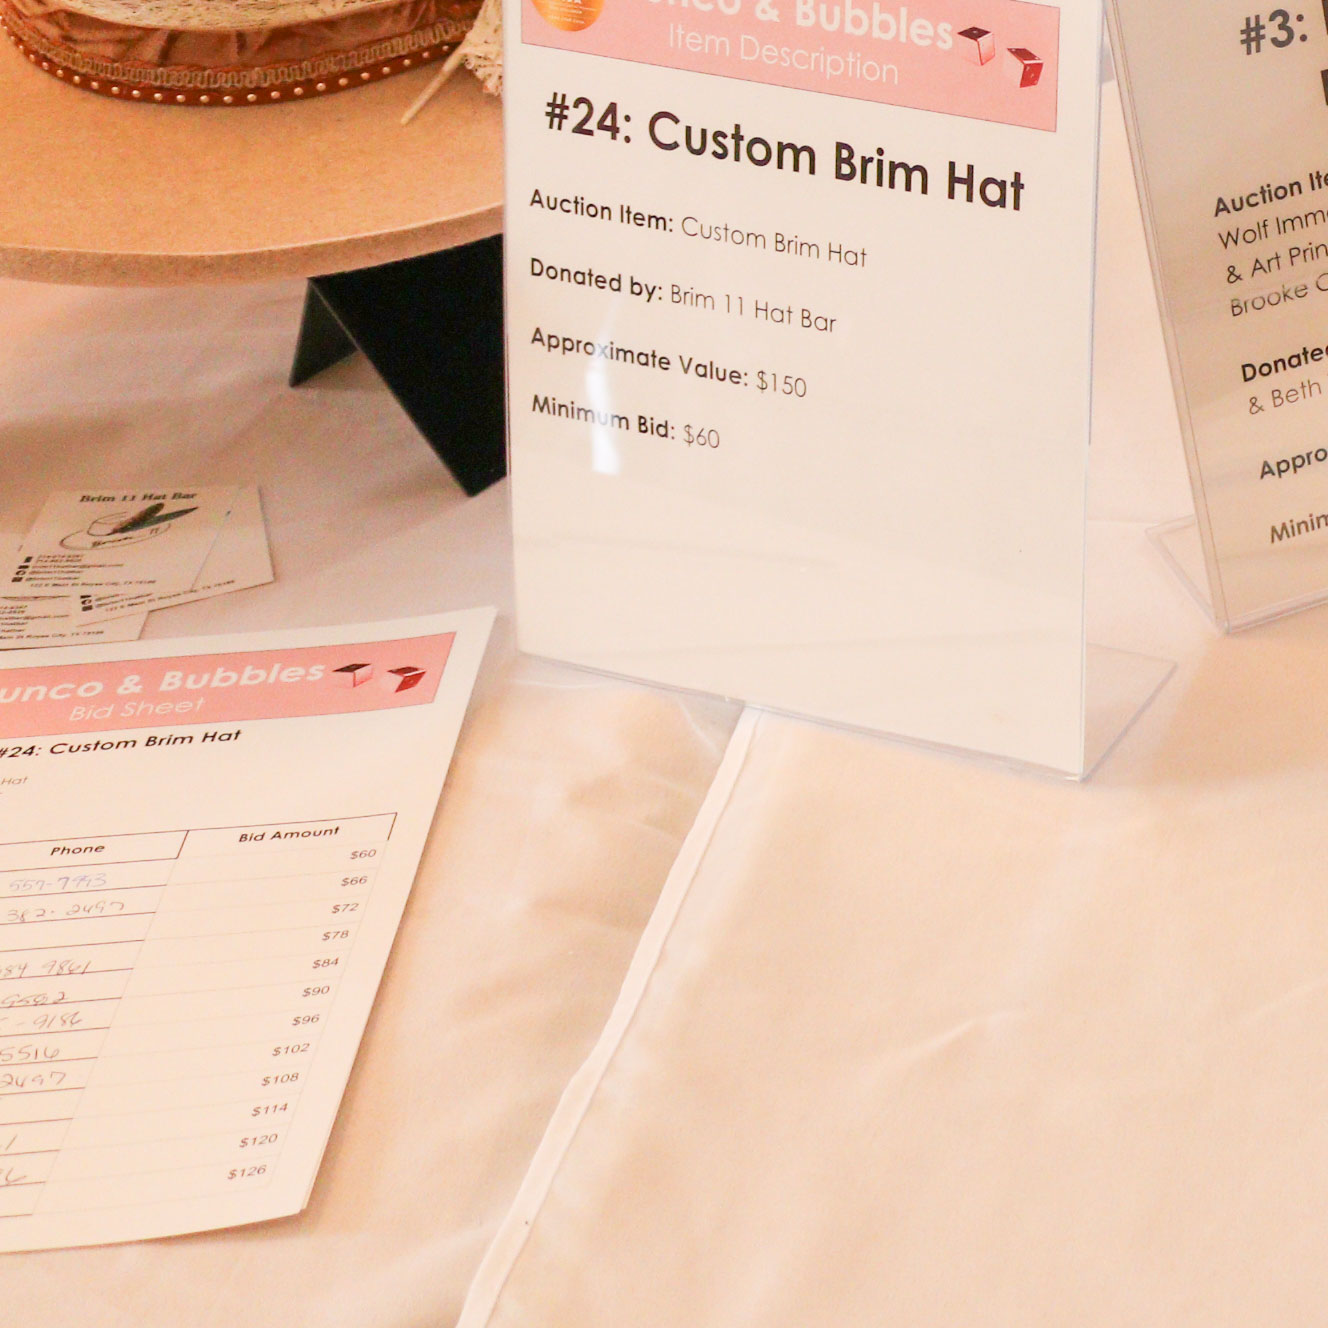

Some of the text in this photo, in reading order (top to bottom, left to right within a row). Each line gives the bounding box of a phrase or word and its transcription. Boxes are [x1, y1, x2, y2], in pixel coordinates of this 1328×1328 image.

[1239, 8, 1308, 56] #3:
[669, 22, 898, 85] Item Description
[544, 91, 1024, 211] #24: Custom Brim Hat
[1213, 180, 1302, 217] Auction
[1217, 218, 1268, 250] Wolf
[530, 256, 836, 332] Donated by: Brim 11 Hat Bar
[530, 326, 808, 398] Approximate Value: $150
[0, 660, 326, 704] unco & Bubbles
[0, 729, 241, 758] #24: Custom Brim Hat
[349, 848, 377, 860] $60
[271, 1042, 310, 1057] $102
[226, 1164, 267, 1180] $126
